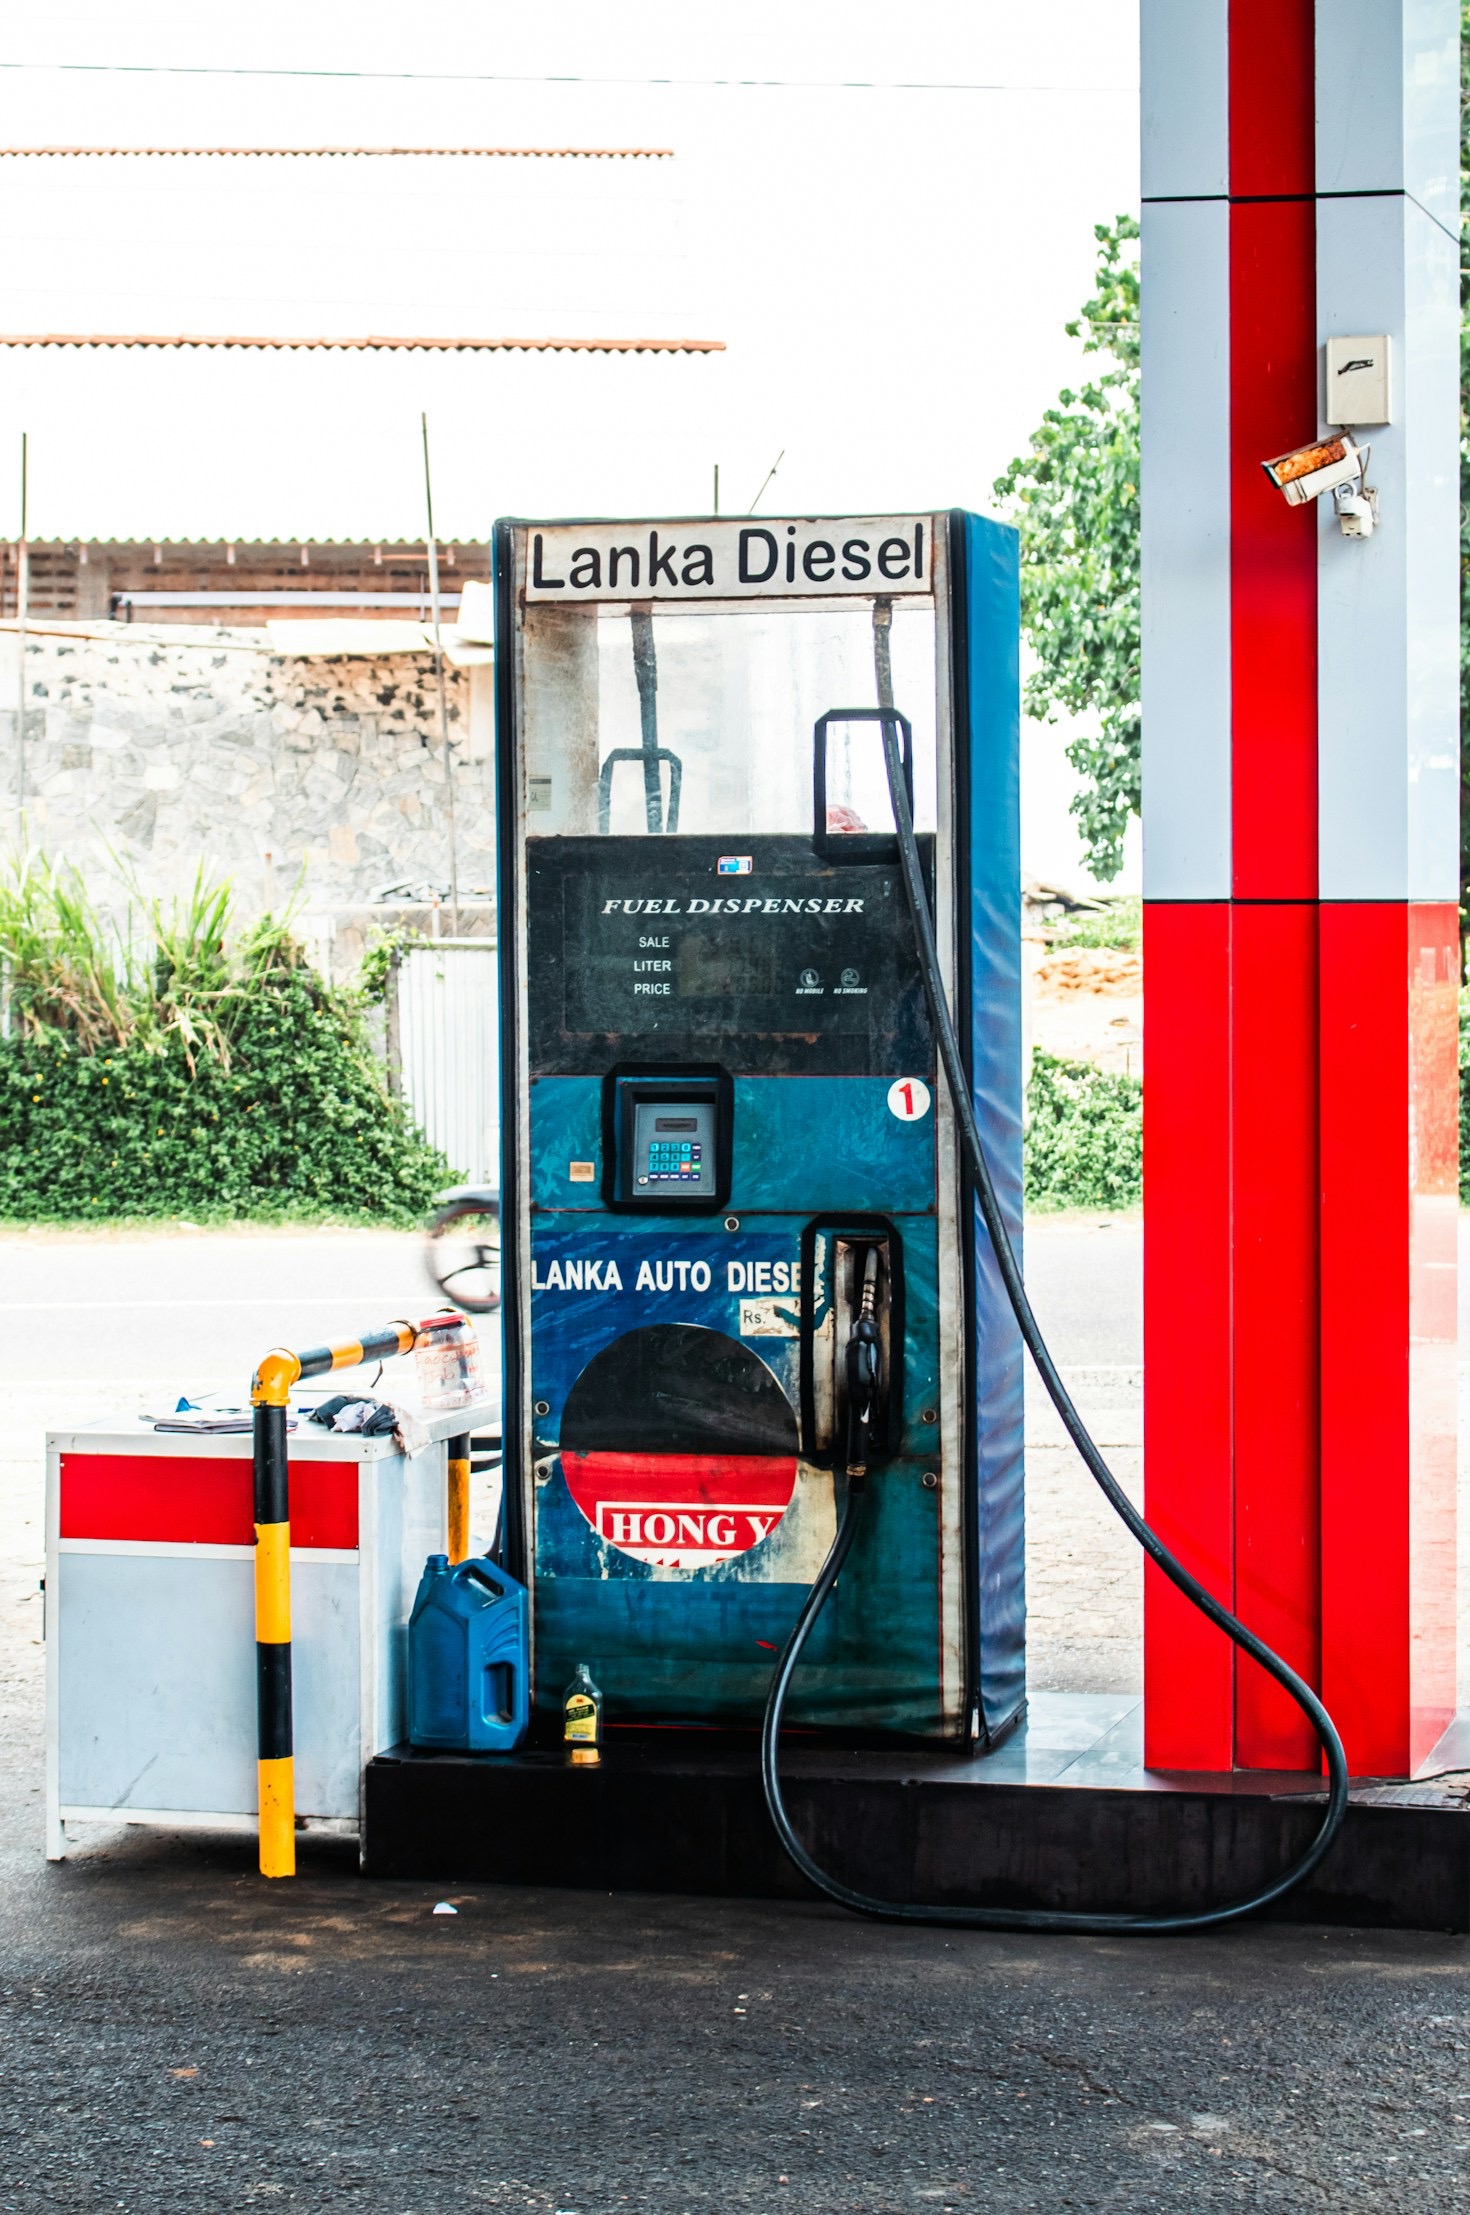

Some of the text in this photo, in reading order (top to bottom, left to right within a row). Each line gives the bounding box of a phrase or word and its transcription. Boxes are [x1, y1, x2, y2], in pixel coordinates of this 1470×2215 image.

[533, 523, 924, 589] Lanka Diesel
[602, 898, 865, 914] FUEL DISPENSER
[639, 936, 670, 948] SALE
[634, 960, 672, 972] LITER
[634, 983, 671, 995] PRICE
[898, 1083, 914, 1114] 1
[532, 1259, 801, 1292] LANKA AUTO DIESE
[743, 1309, 766, 1325] Rs.
[611, 1513, 736, 1545] HONG
